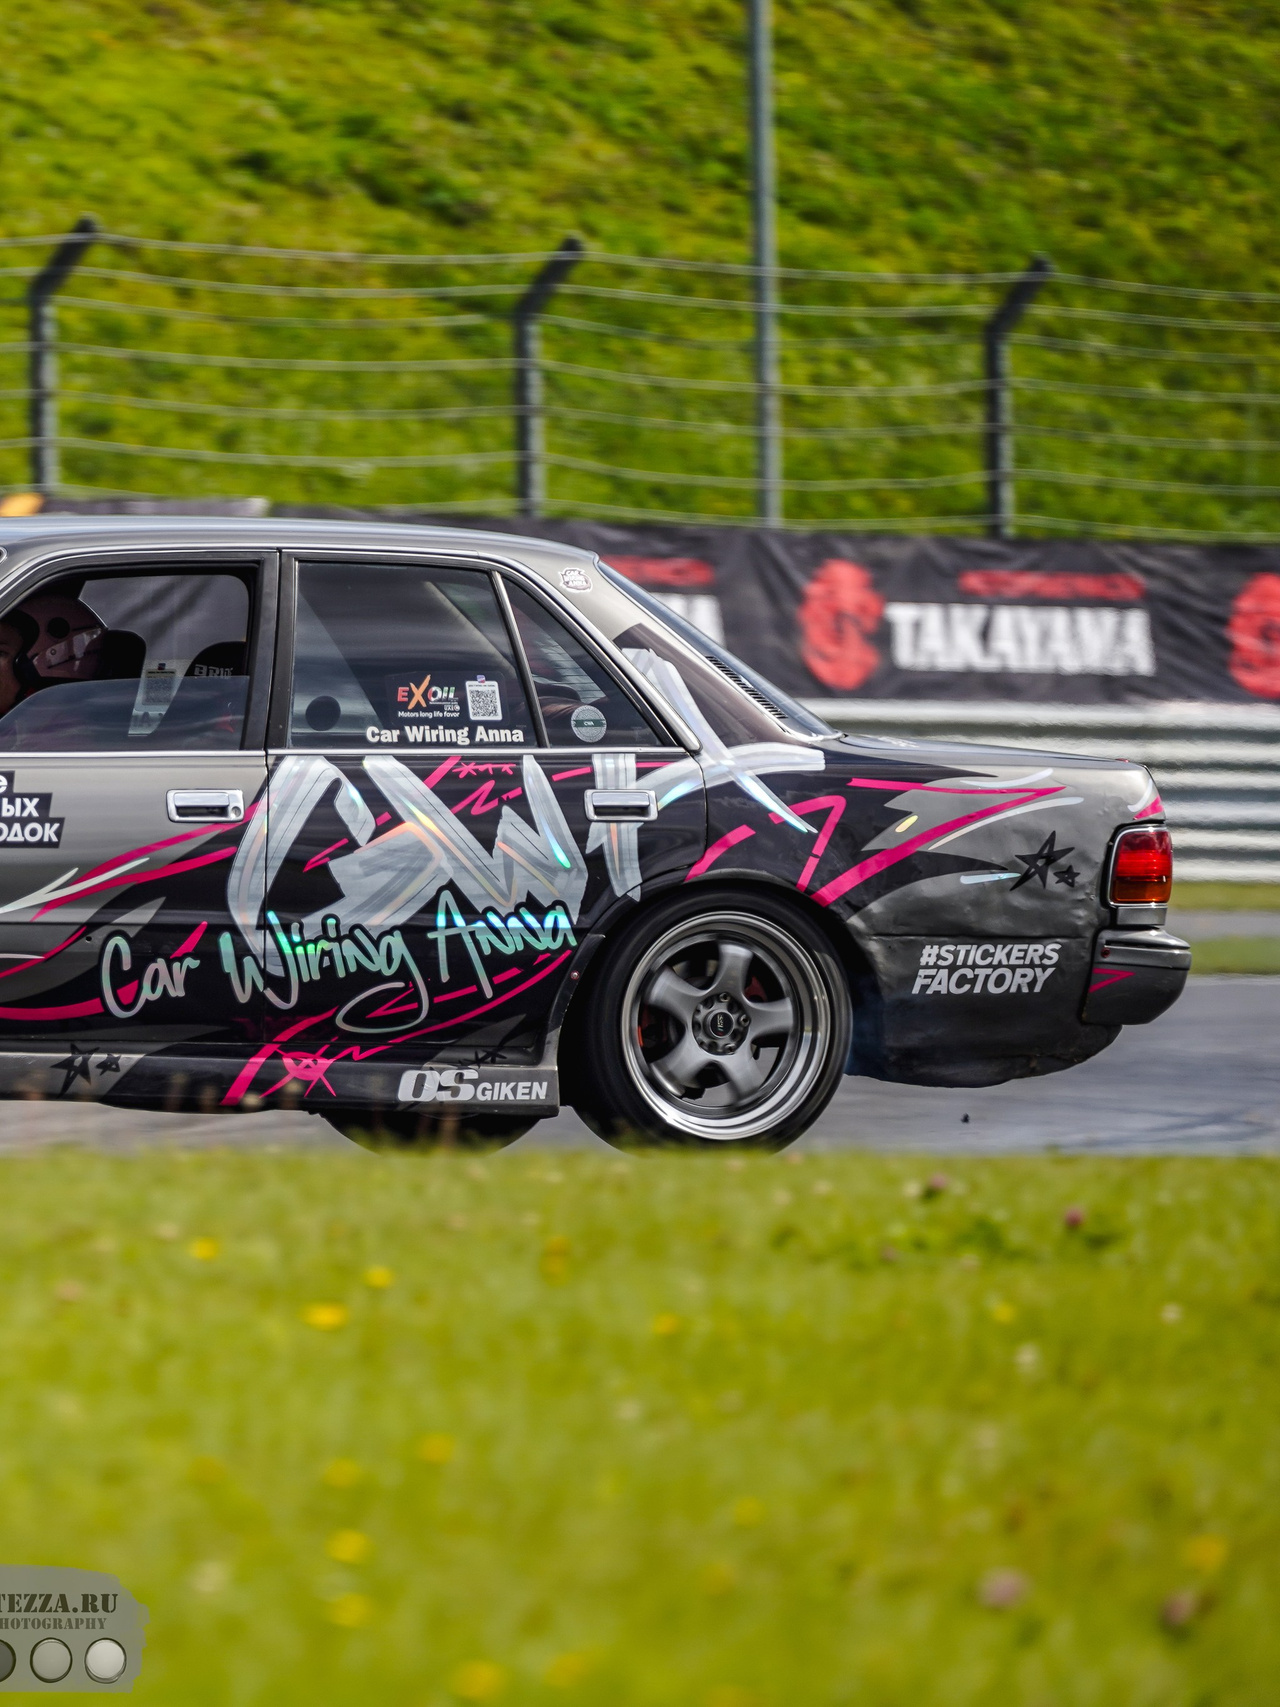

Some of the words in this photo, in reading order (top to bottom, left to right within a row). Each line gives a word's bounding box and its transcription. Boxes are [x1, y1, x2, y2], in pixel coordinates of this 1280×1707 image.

[887, 602, 1156, 678] TAKAYAMA
[397, 674, 458, 710] EXOIL
[420, 710, 433, 718] long
[366, 725, 400, 743] Car
[405, 725, 470, 746] Wiring
[475, 726, 524, 743] Anna
[102, 935, 201, 1019] Car
[220, 910, 429, 1033] Wiring
[427, 890, 578, 999] Anna
[921, 943, 1062, 966] #STICKERS
[912, 967, 1056, 995] FACTORY
[397, 1068, 478, 1103] OS
[476, 1082, 548, 1100] GIKEN
